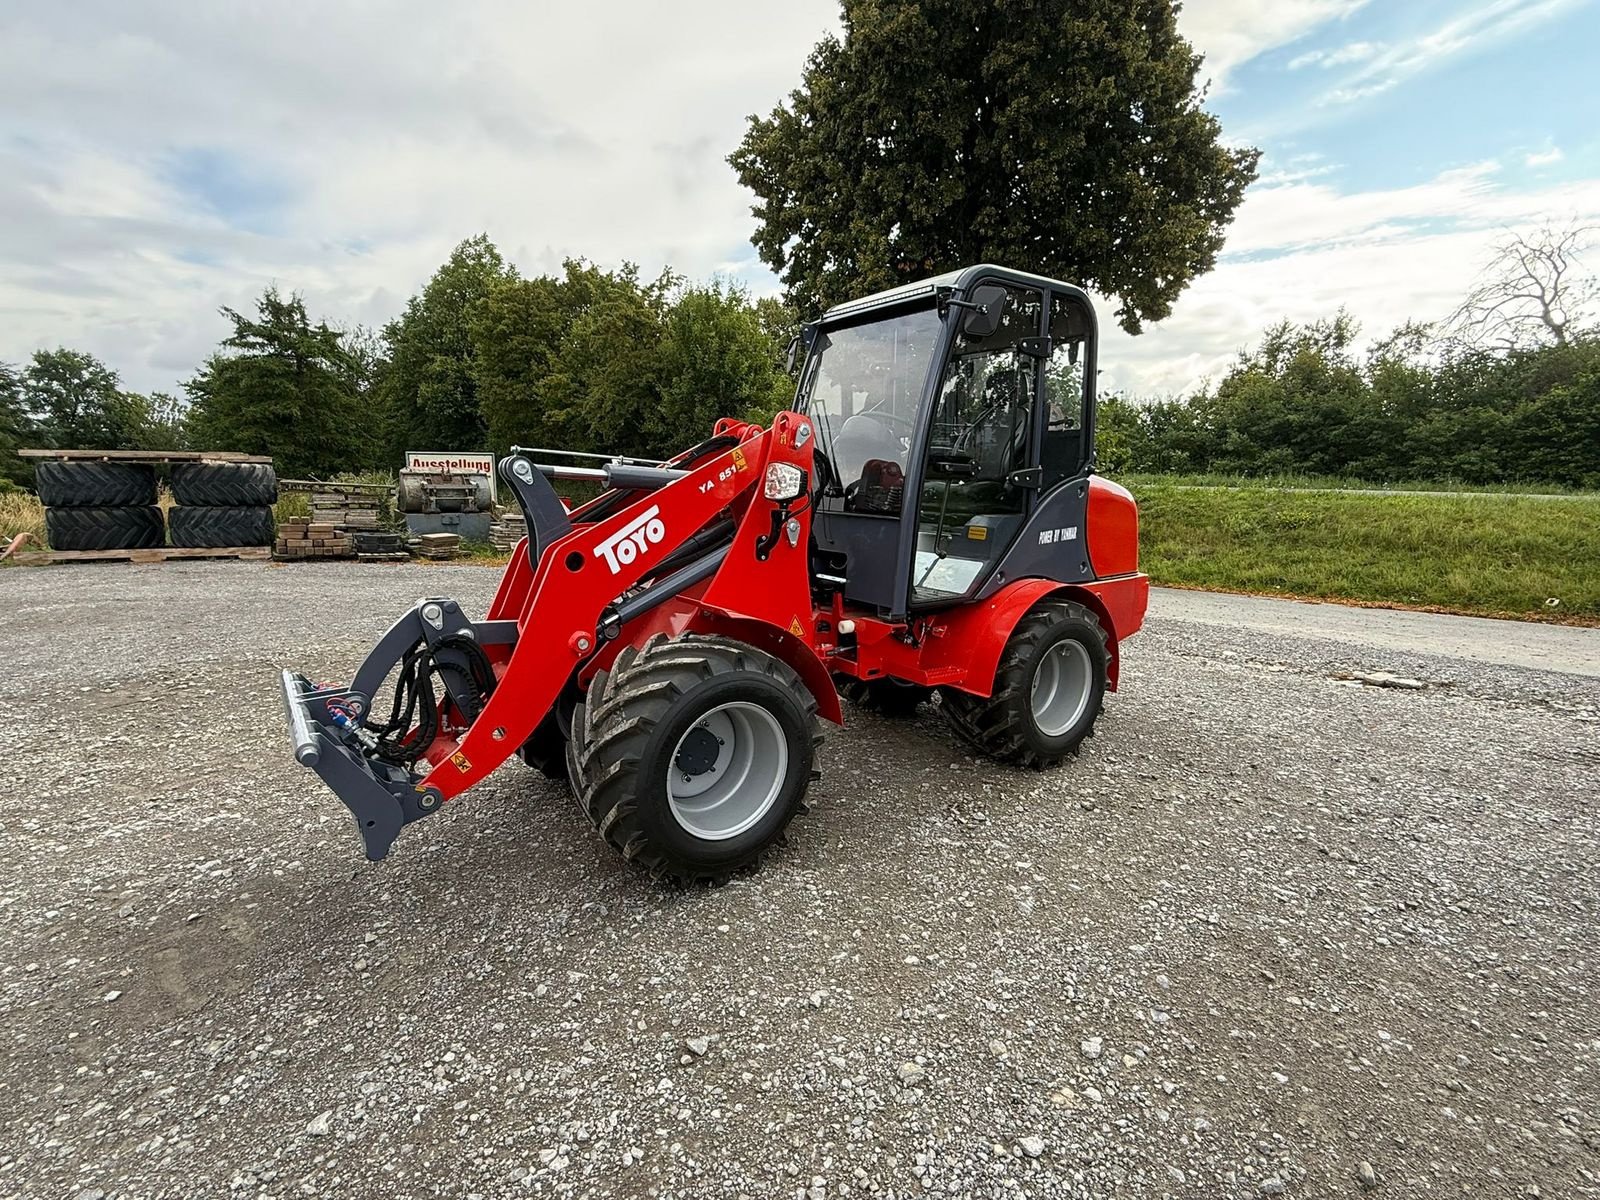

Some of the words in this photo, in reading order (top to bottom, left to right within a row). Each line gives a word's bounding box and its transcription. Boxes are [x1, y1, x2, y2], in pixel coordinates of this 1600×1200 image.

[413, 459, 491, 472] Ausstellung
[699, 480, 715, 494] YA
[719, 464, 737, 481] 851
[593, 504, 665, 575] TOYO
